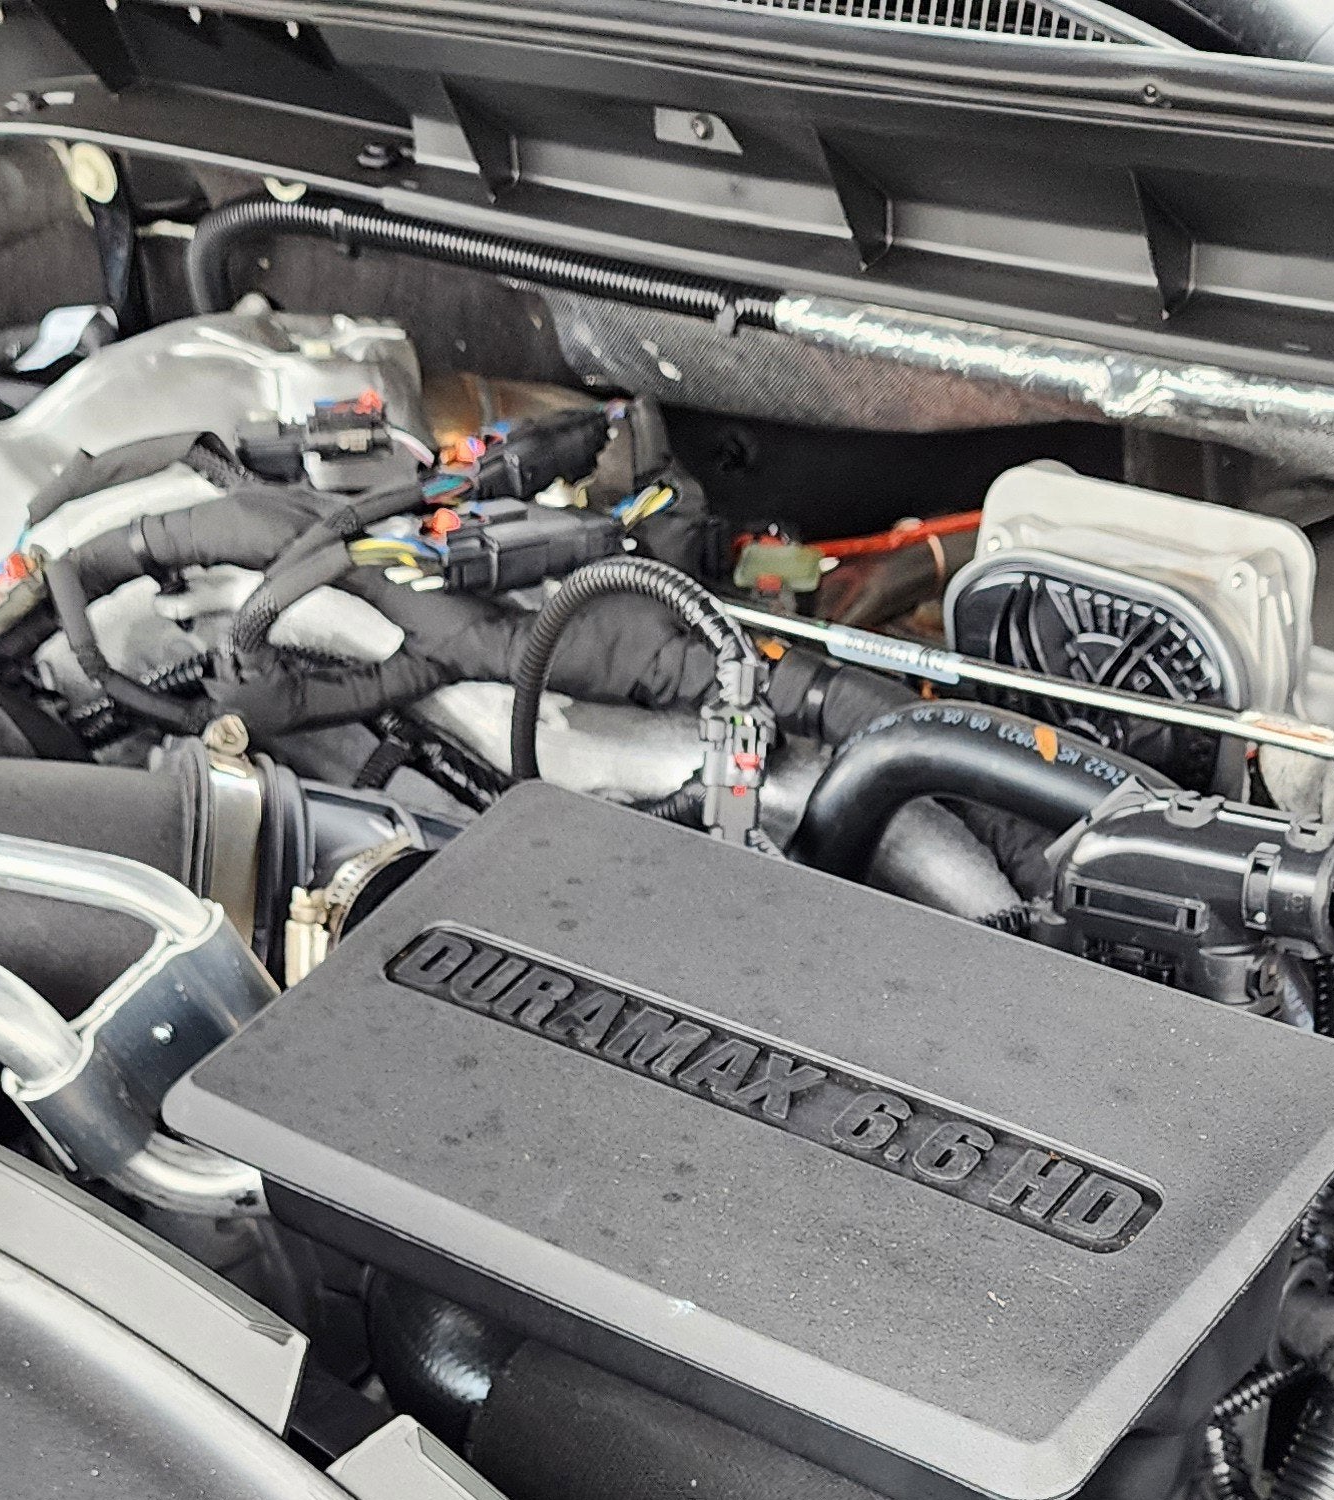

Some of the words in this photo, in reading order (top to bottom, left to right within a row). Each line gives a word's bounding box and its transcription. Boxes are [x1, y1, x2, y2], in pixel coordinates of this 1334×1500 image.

[394, 931, 827, 1120] DURAMAX
[830, 1090, 995, 1183] 6.6
[989, 1147, 1144, 1241] HD
